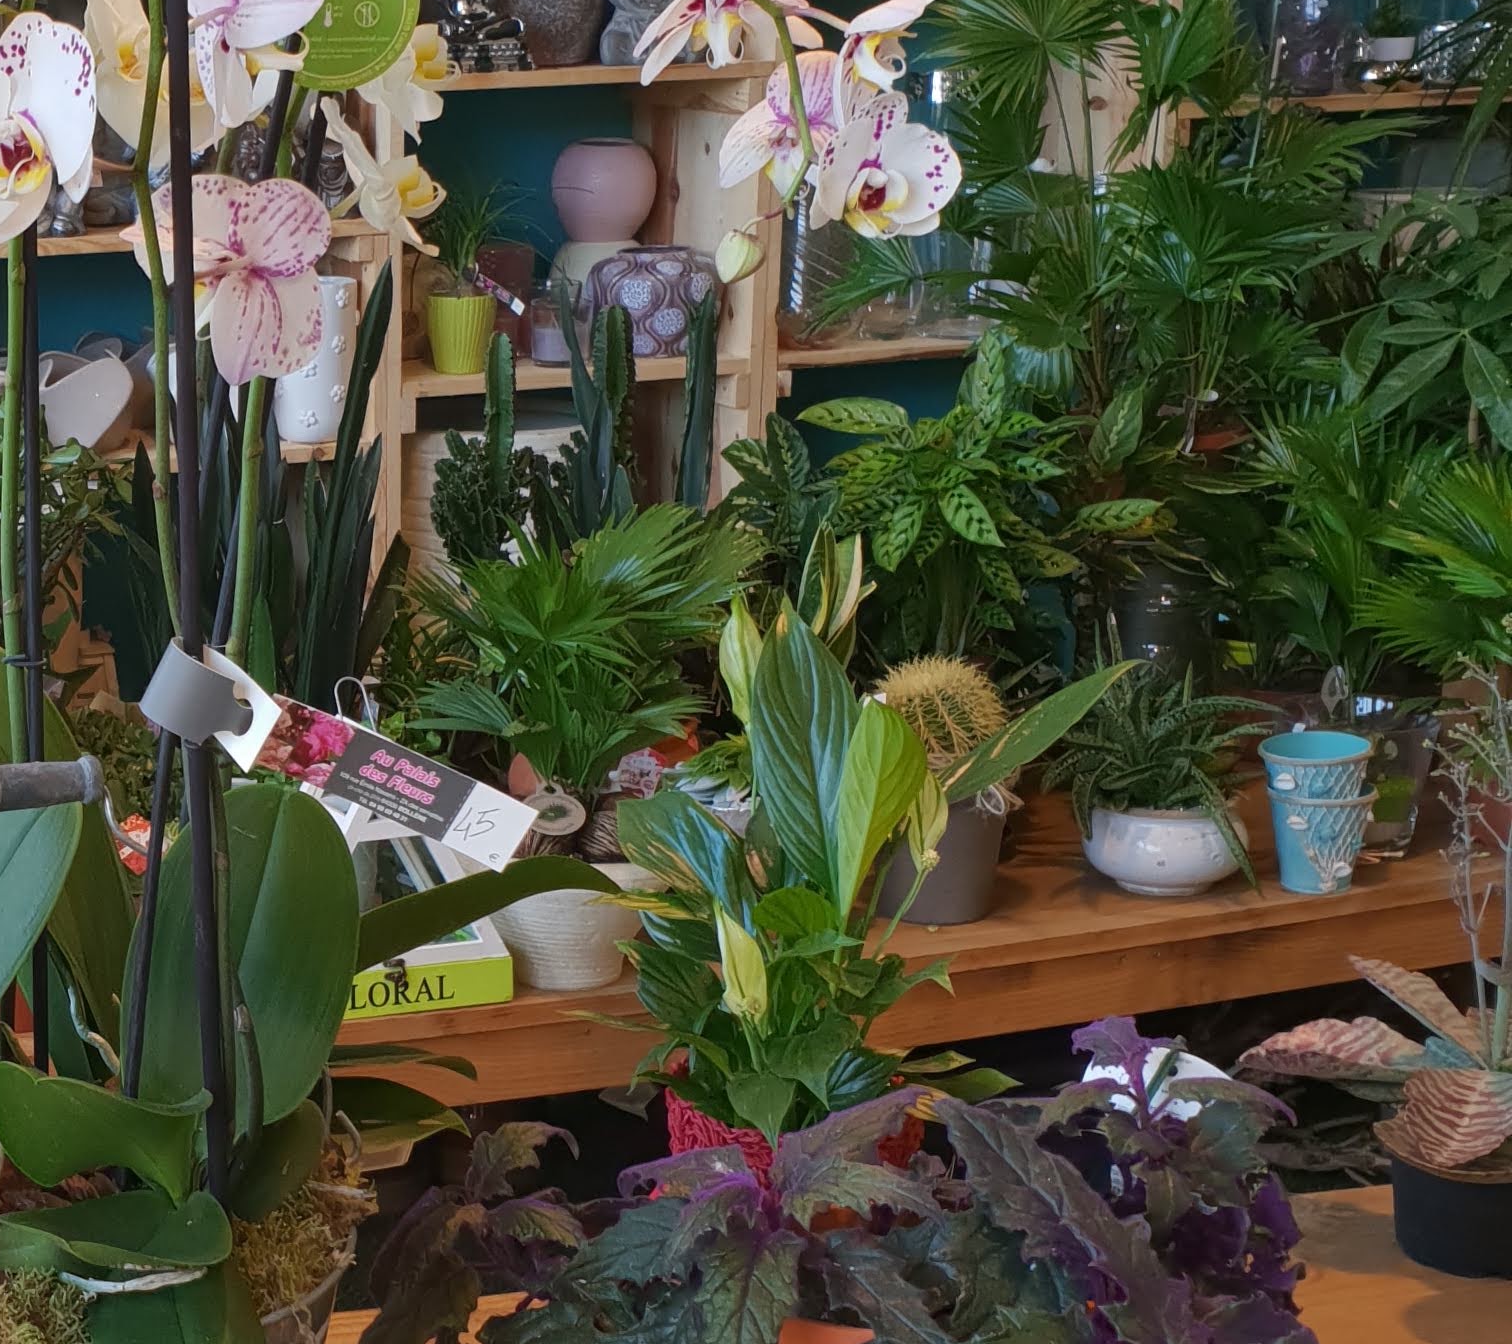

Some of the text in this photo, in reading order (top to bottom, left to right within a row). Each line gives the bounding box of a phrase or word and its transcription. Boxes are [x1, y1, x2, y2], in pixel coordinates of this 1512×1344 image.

[358, 763, 388, 784] des
[386, 774, 435, 804] Fleurs
[370, 749, 441, 788] Au Palais
[453, 807, 500, 841] 45
[348, 974, 455, 1010] LORAL
